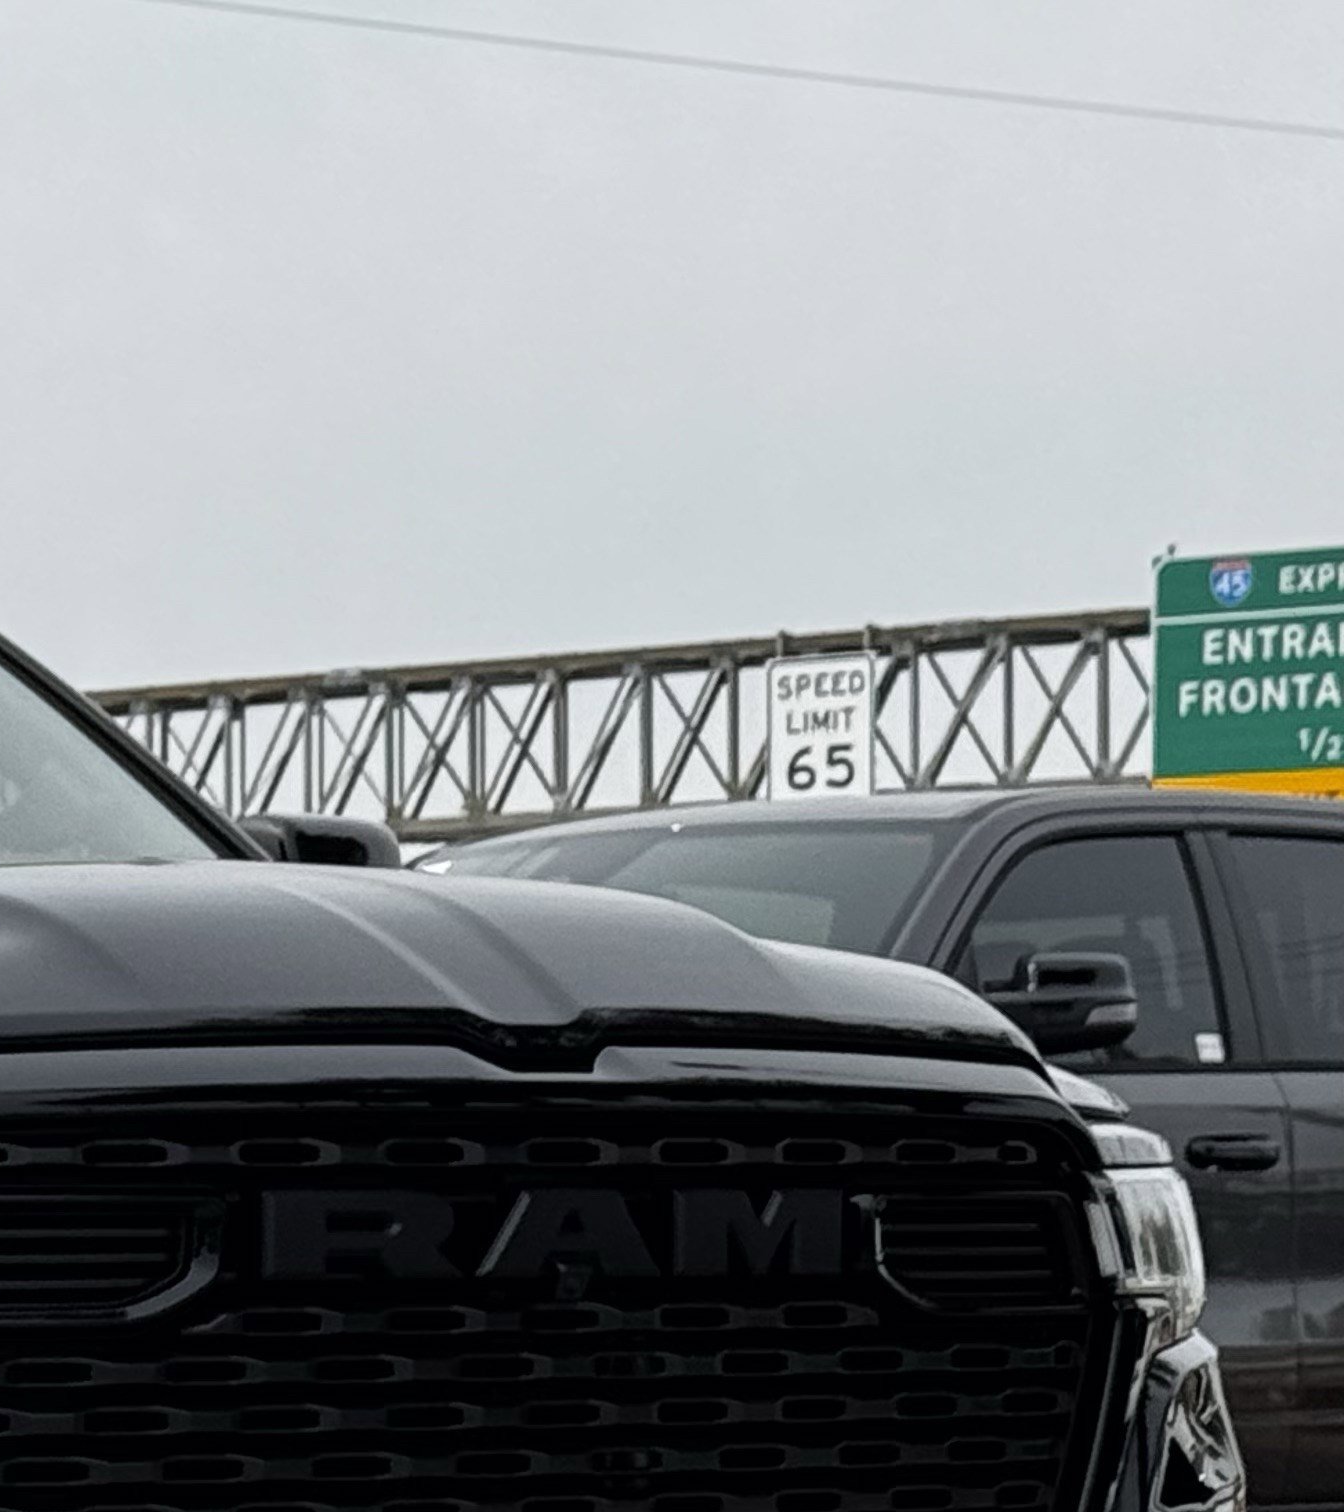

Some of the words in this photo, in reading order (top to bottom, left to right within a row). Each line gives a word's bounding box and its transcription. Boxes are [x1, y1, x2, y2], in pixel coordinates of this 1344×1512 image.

[1215, 570, 1247, 598] 45
[1200, 621, 1344, 666] ENTRA
[777, 669, 865, 699] SPEED
[1178, 671, 1342, 718] FRONTA
[786, 707, 856, 736] LIMIT
[786, 744, 855, 790] 65
[261, 1188, 845, 1279] RAM
